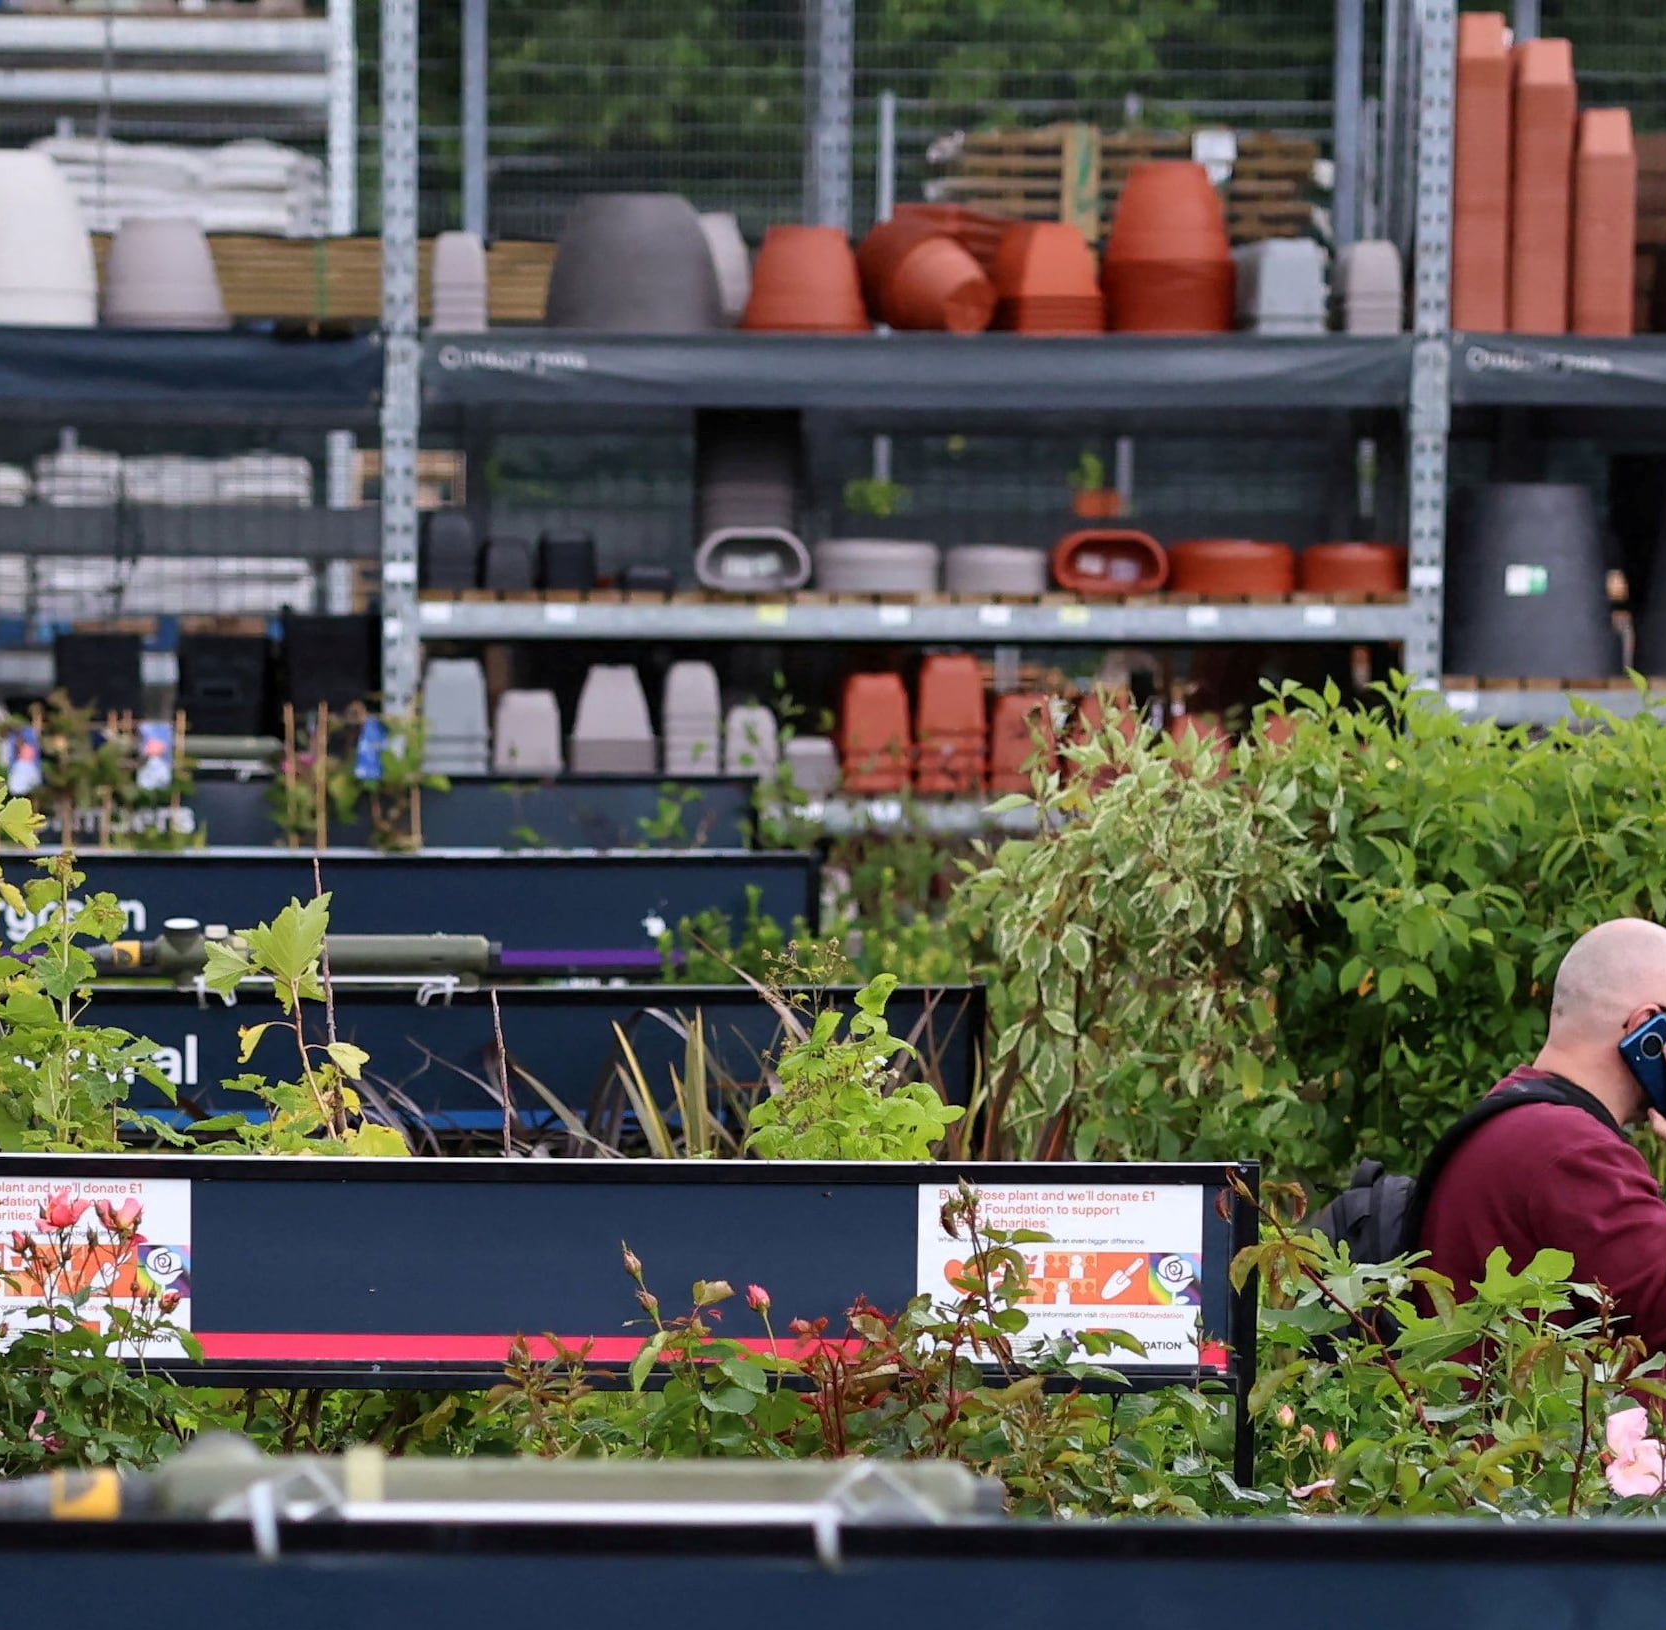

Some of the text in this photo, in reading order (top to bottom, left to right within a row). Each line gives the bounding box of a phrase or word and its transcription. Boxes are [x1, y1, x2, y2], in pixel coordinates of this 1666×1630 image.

[28, 1182, 51, 1194] and
[83, 1184, 126, 1195] donate
[129, 1184, 142, 1194] £1
[1008, 1190, 1038, 1203] plant
[1041, 1190, 1064, 1201] and
[1067, 1190, 1094, 1202] we'll
[1096, 1190, 1139, 1202] donate
[1142, 1190, 1156, 1202] £1
[984, 1203, 1054, 1215] Foundation
[1057, 1204, 1069, 1215] to
[1071, 1205, 1120, 1218] support
